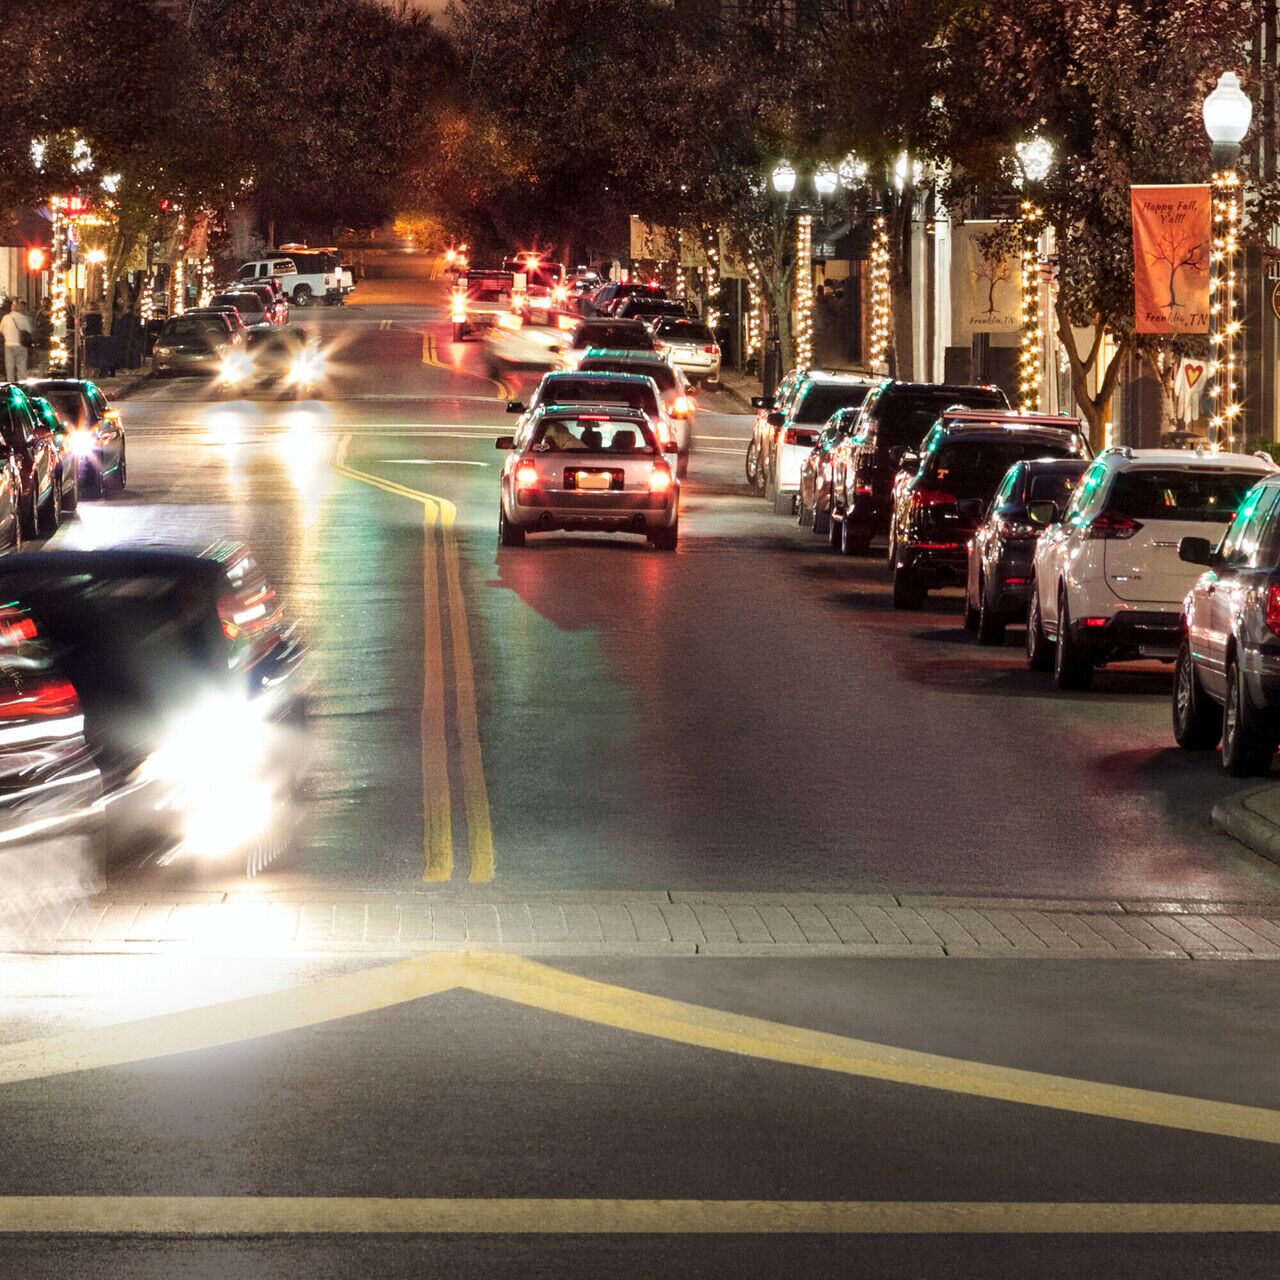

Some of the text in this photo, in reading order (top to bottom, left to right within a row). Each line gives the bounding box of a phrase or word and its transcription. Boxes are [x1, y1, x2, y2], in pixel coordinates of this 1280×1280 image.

[1142, 200, 1197, 214] Happy Fall,
[1161, 213, 1185, 224] Y'all!
